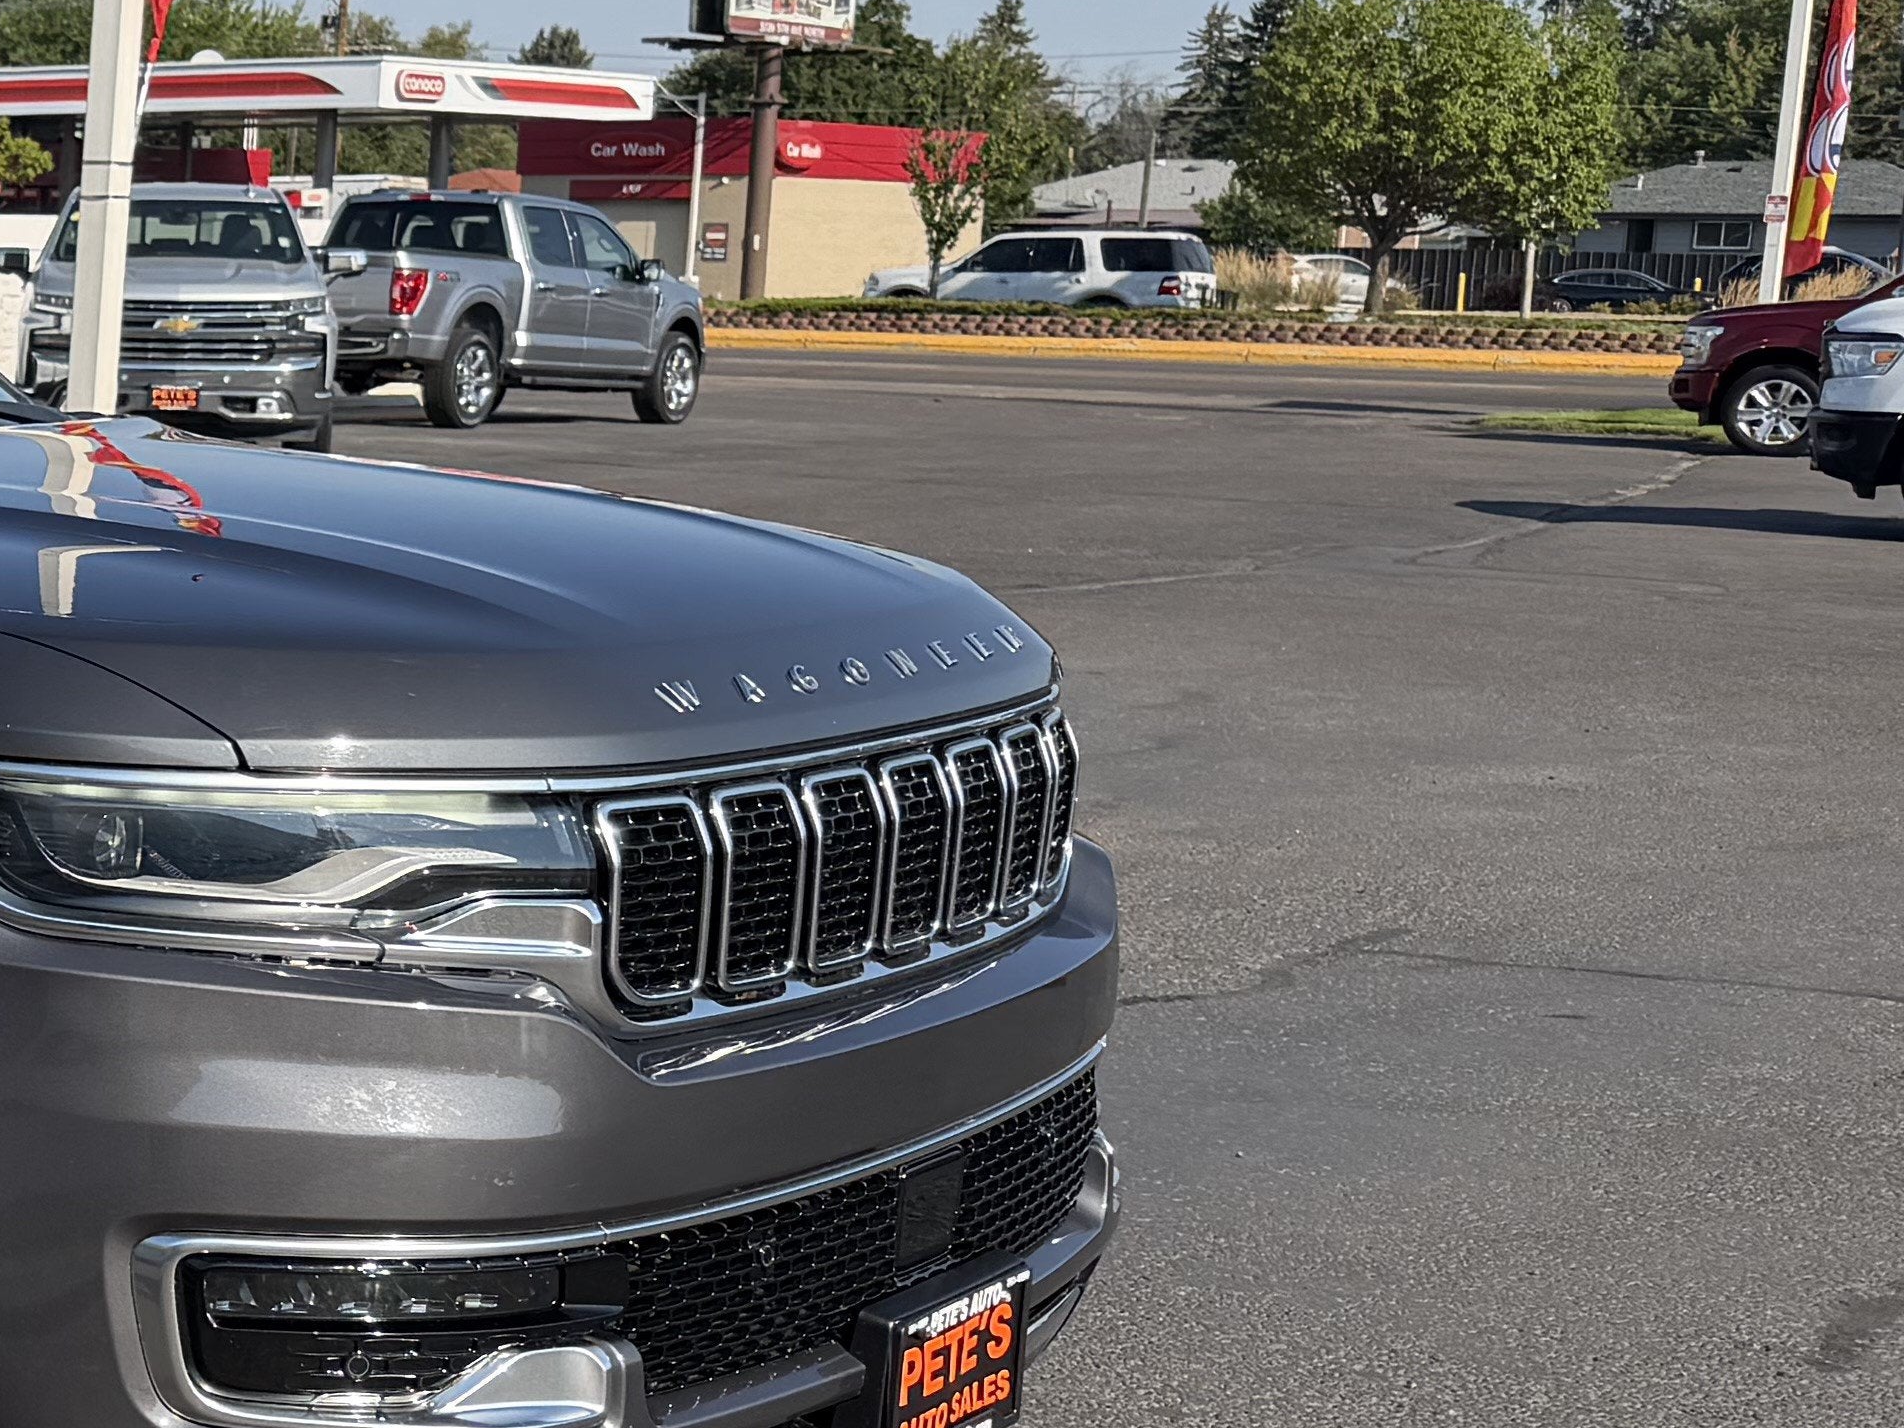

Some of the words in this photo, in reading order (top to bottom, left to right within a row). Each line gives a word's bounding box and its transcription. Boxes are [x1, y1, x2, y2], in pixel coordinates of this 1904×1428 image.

[591, 143, 617, 158] Car
[622, 142, 666, 157] Wash
[654, 624, 1025, 712] WAGONEER
[898, 1303, 1013, 1407] PETE'S
[949, 1369, 1011, 1424] SALES
